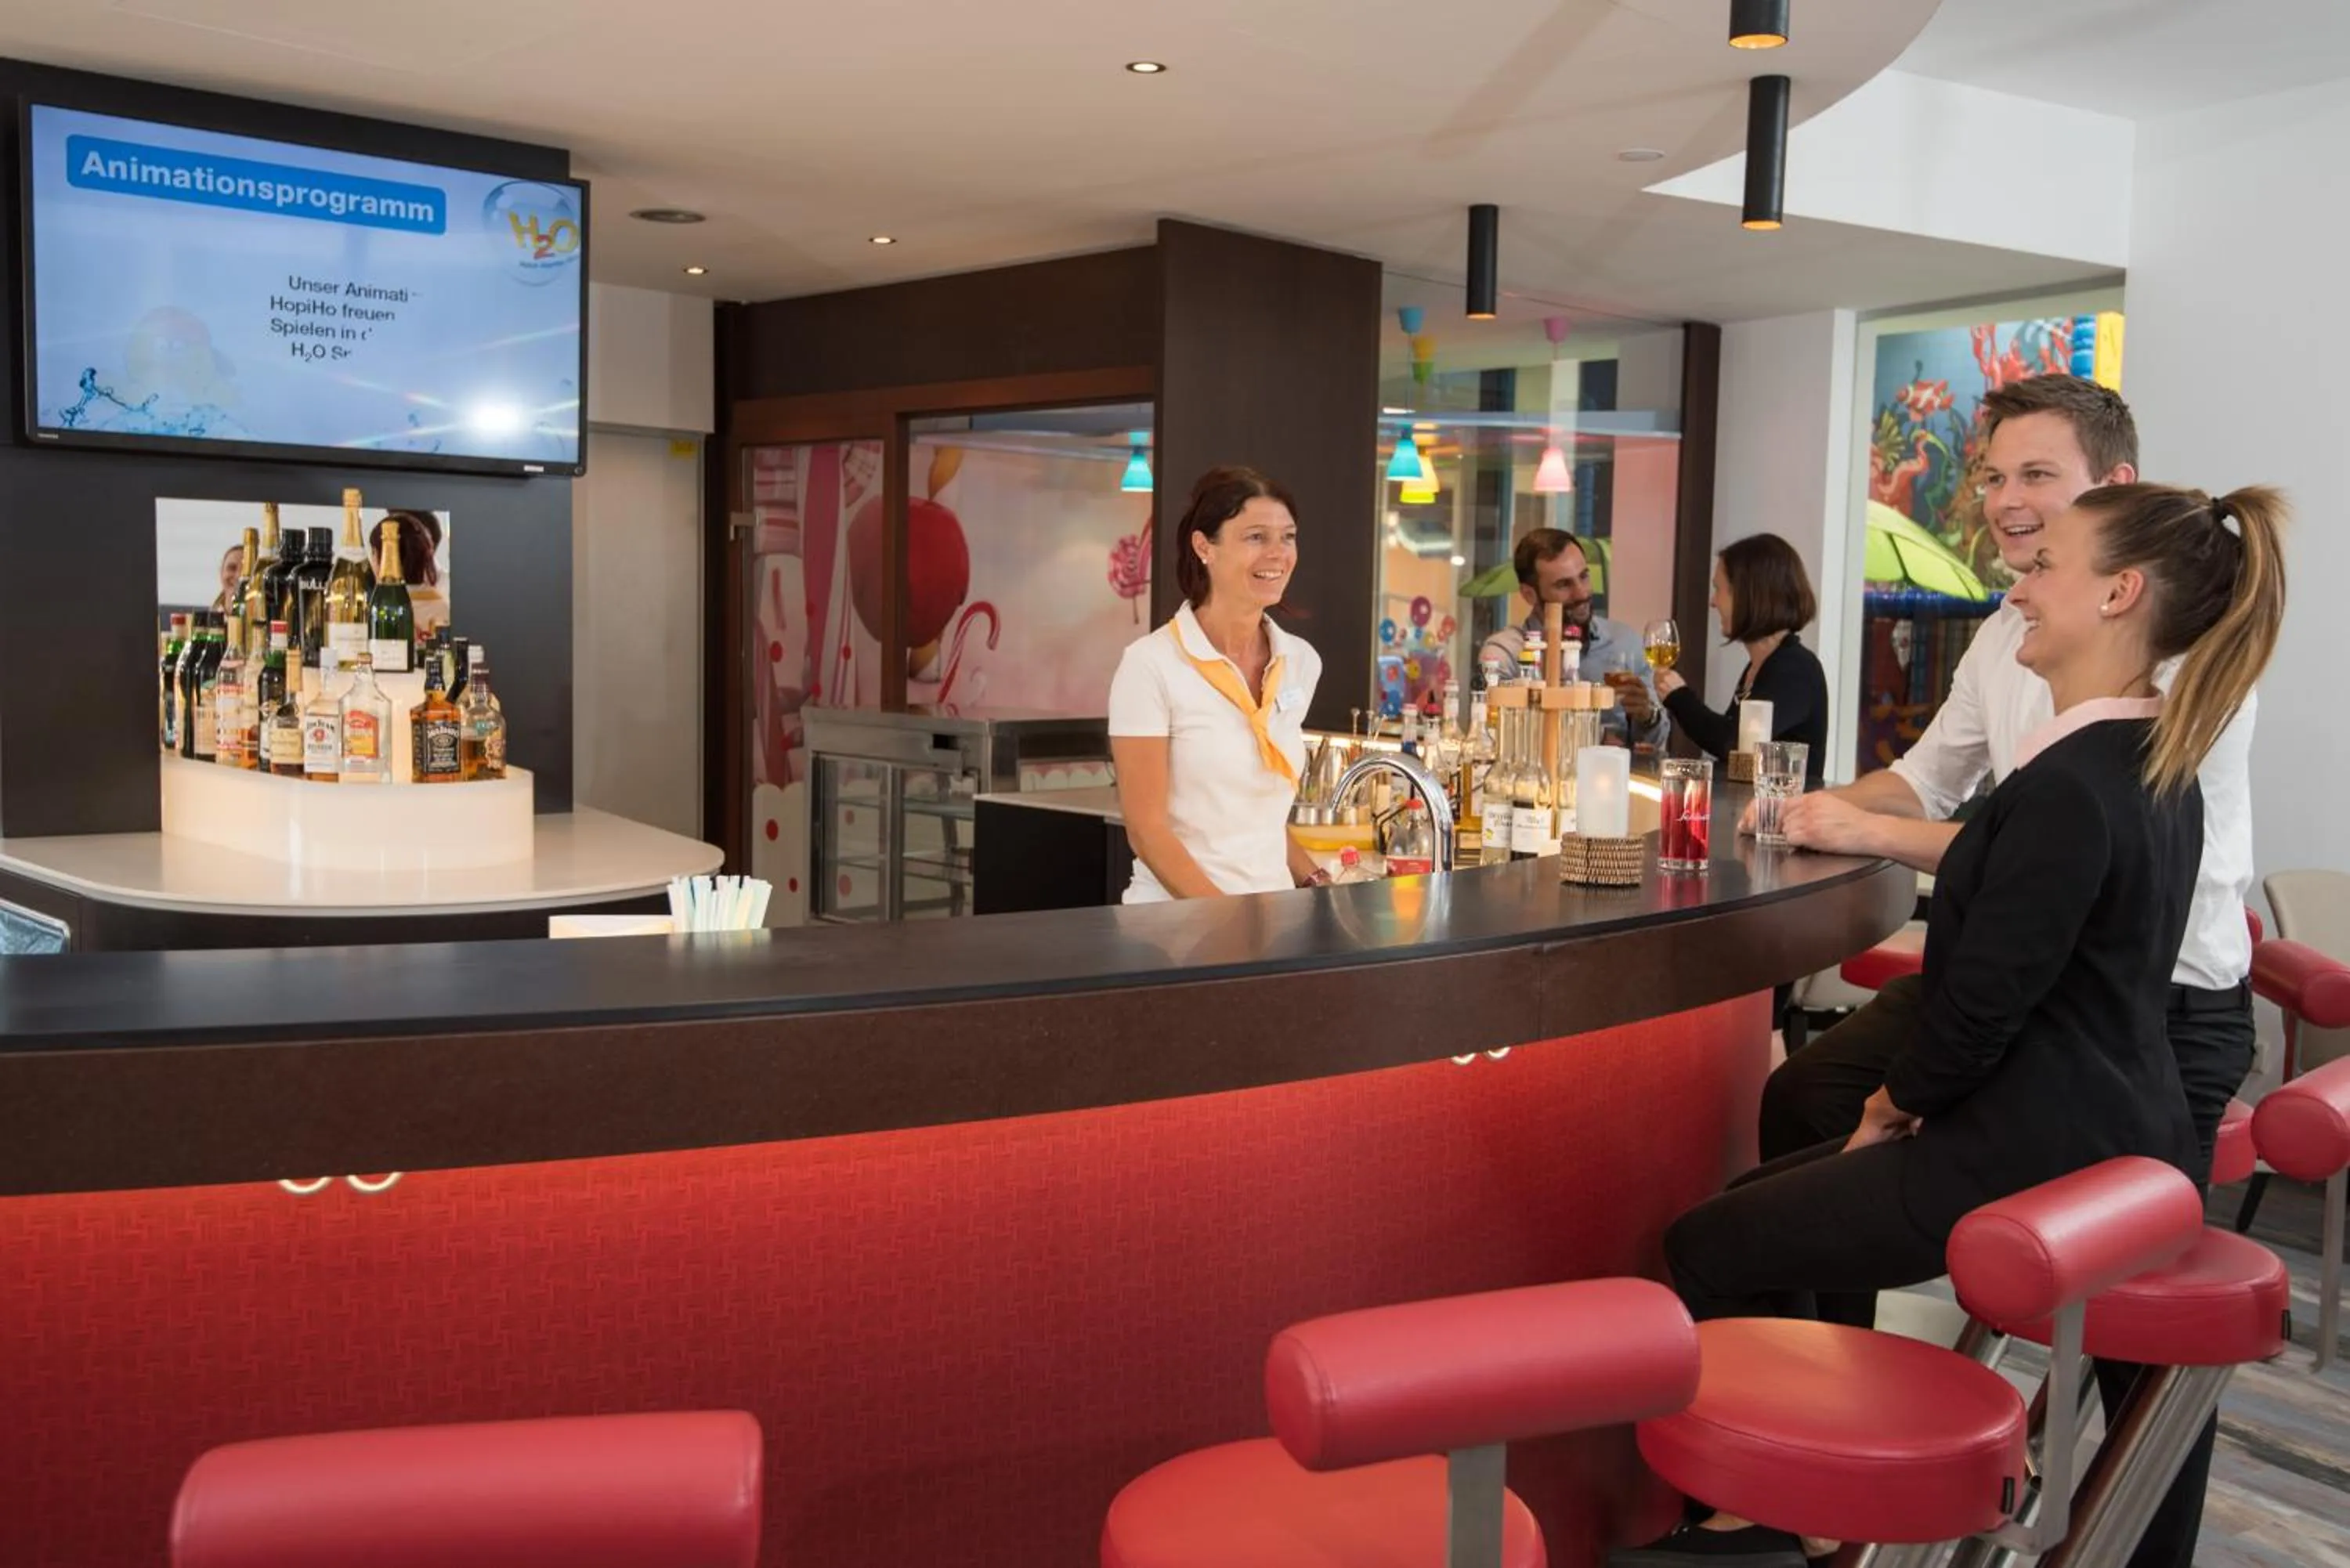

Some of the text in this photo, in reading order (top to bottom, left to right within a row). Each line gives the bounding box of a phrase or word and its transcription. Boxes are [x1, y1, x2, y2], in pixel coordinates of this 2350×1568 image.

[81, 151, 434, 222] Animationsprogramm
[289, 275, 410, 303] Unser Animati
[270, 294, 395, 321] HopiHo freuen
[270, 317, 336, 338] Spielen
[341, 327, 356, 340] in
